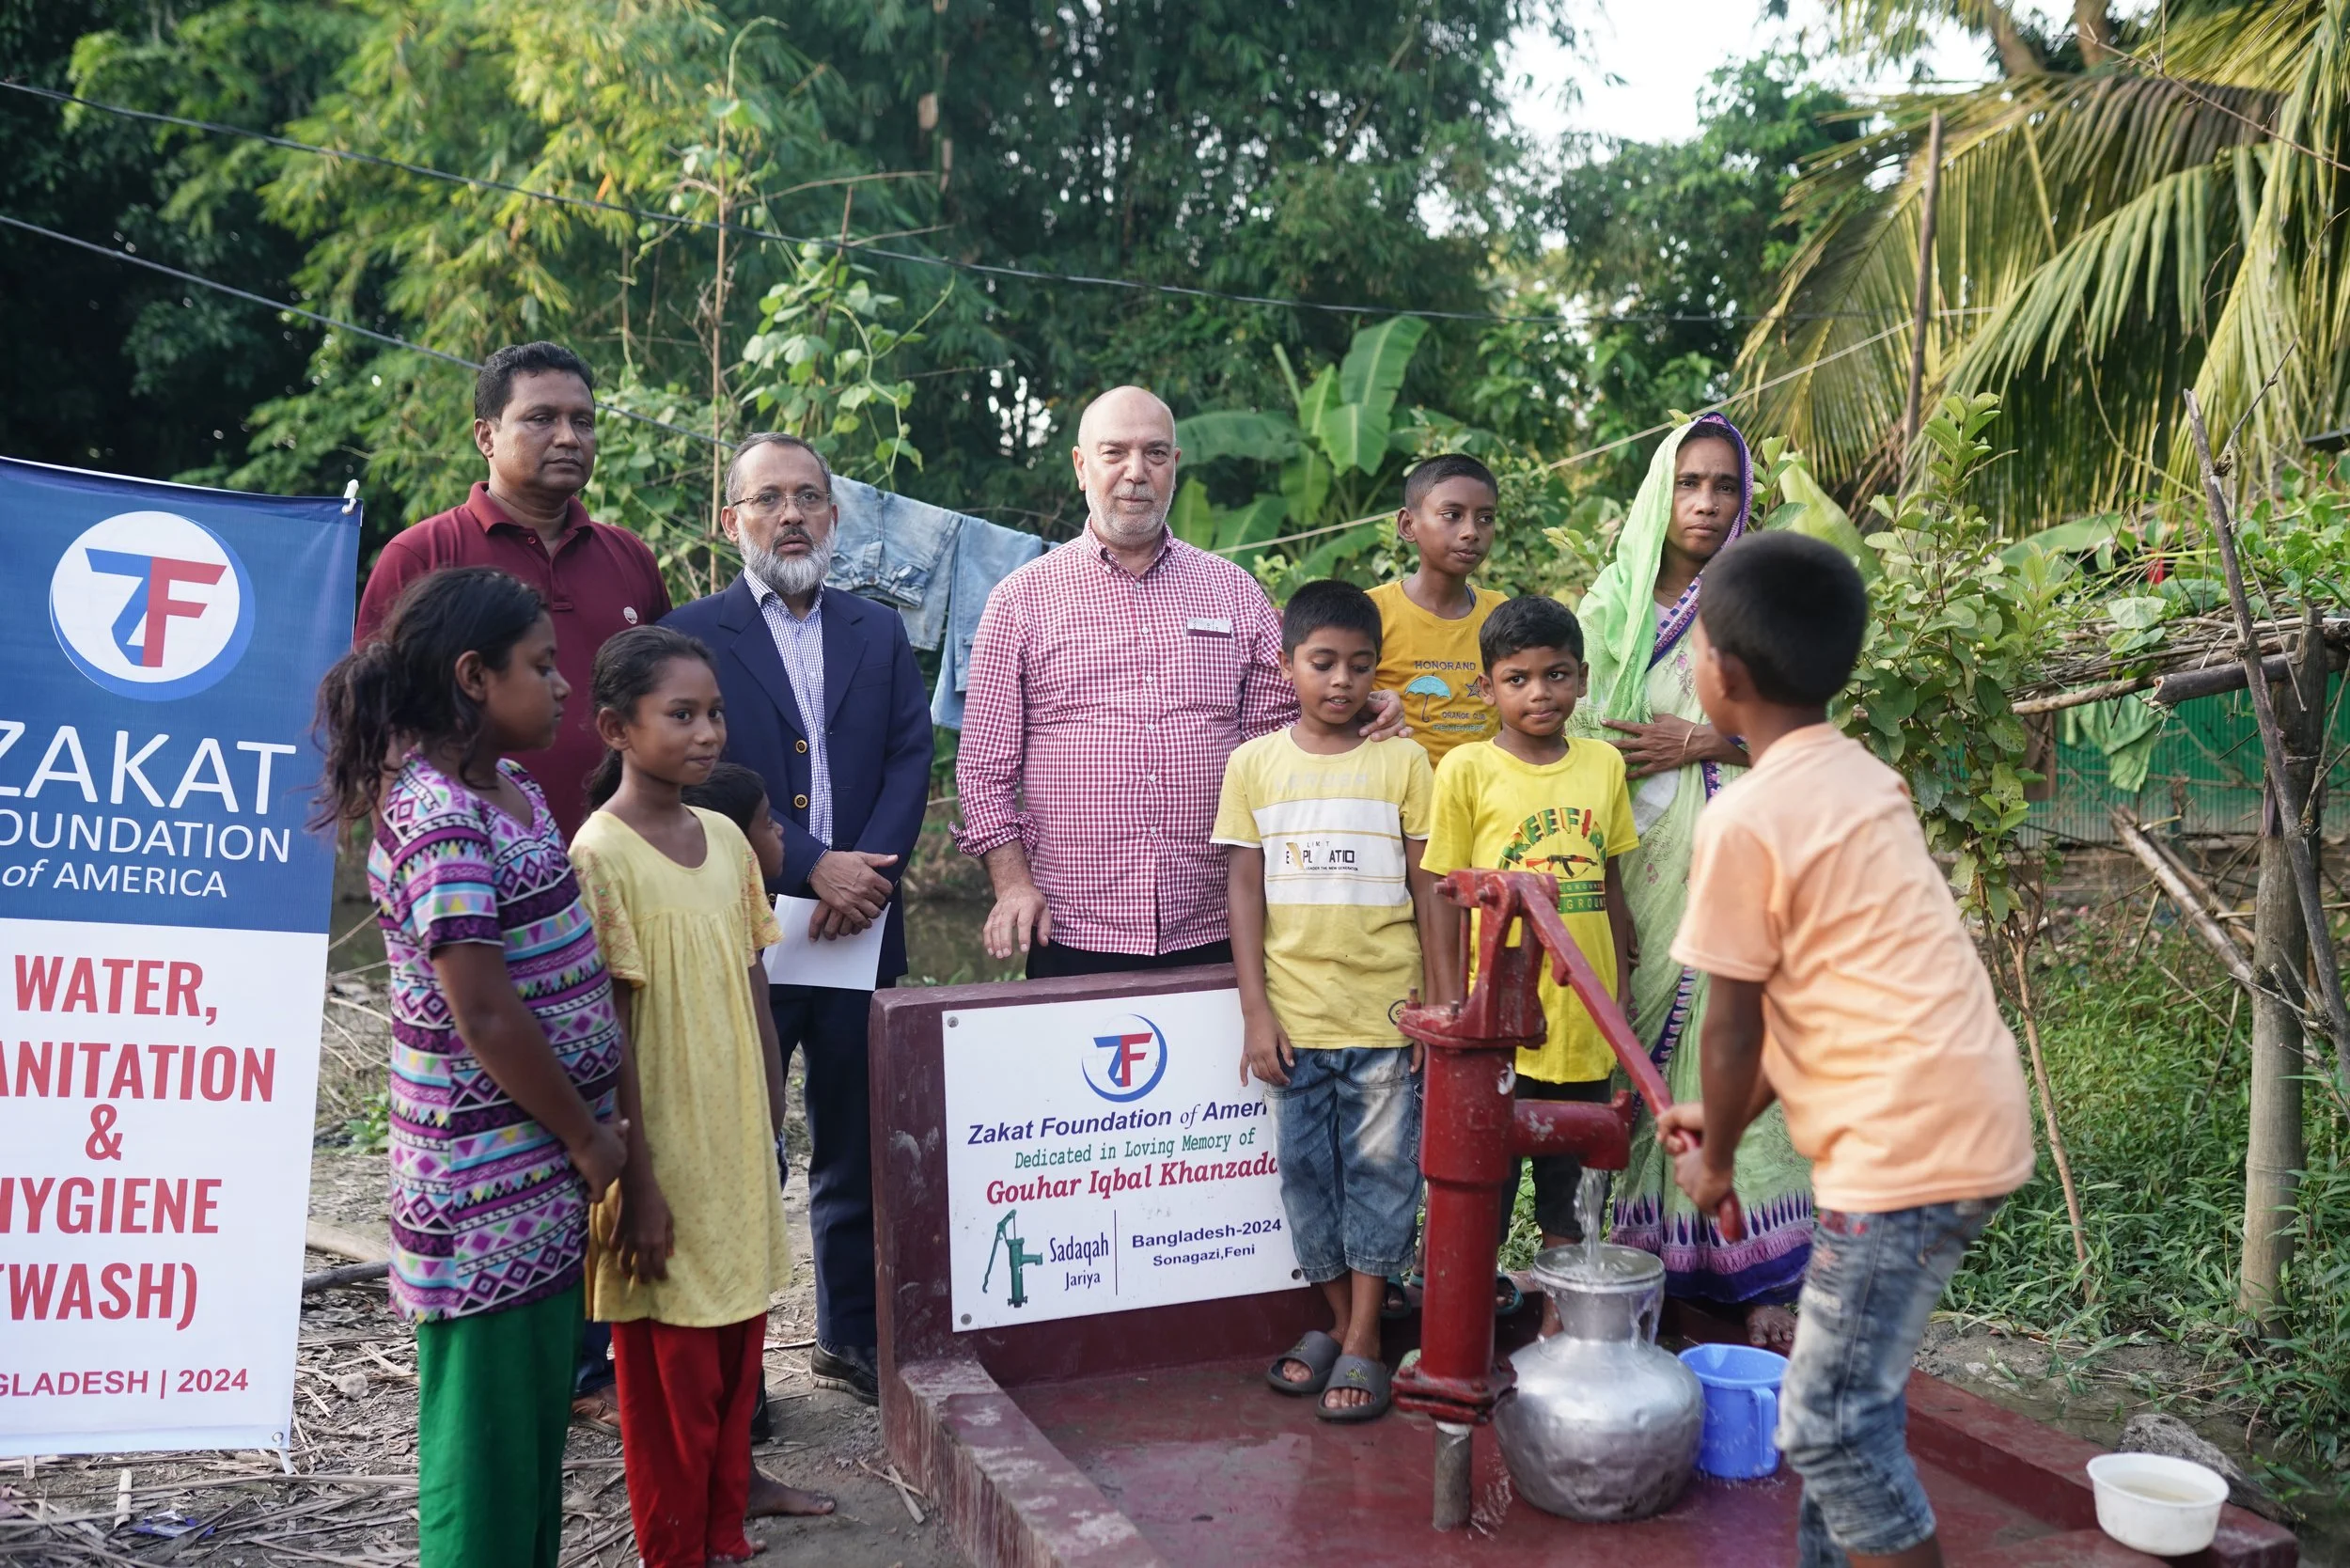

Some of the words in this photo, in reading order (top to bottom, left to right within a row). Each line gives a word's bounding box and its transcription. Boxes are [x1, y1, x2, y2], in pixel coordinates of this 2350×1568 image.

[1442, 711, 1469, 720] ORANGE
[2, 858, 49, 888] of
[54, 862, 227, 898] AMERICA
[14, 955, 218, 1026] WATER,
[0, 1041, 276, 1103] NITATION
[85, 1103, 124, 1161] &
[968, 1120, 1034, 1145] Zakat
[1040, 1110, 1172, 1137] Foundation
[1180, 1104, 1201, 1130] of
[1014, 1144, 1091, 1168] Dedicated
[1100, 1140, 1117, 1159] in
[1124, 1137, 1175, 1158] Loving
[1182, 1132, 1231, 1152] Memory
[1239, 1127, 1256, 1145] of
[986, 1175, 1082, 1205] Gouhar
[1089, 1165, 1152, 1200] Iqbal
[1049, 1231, 1109, 1266] Sadaqah
[1132, 1218, 1282, 1248] Bangladesh-2024
[1152, 1244, 1256, 1266] Sonagazi,Feni
[1064, 1269, 1101, 1292] Jariya
[178, 1368, 248, 1393] 2024
